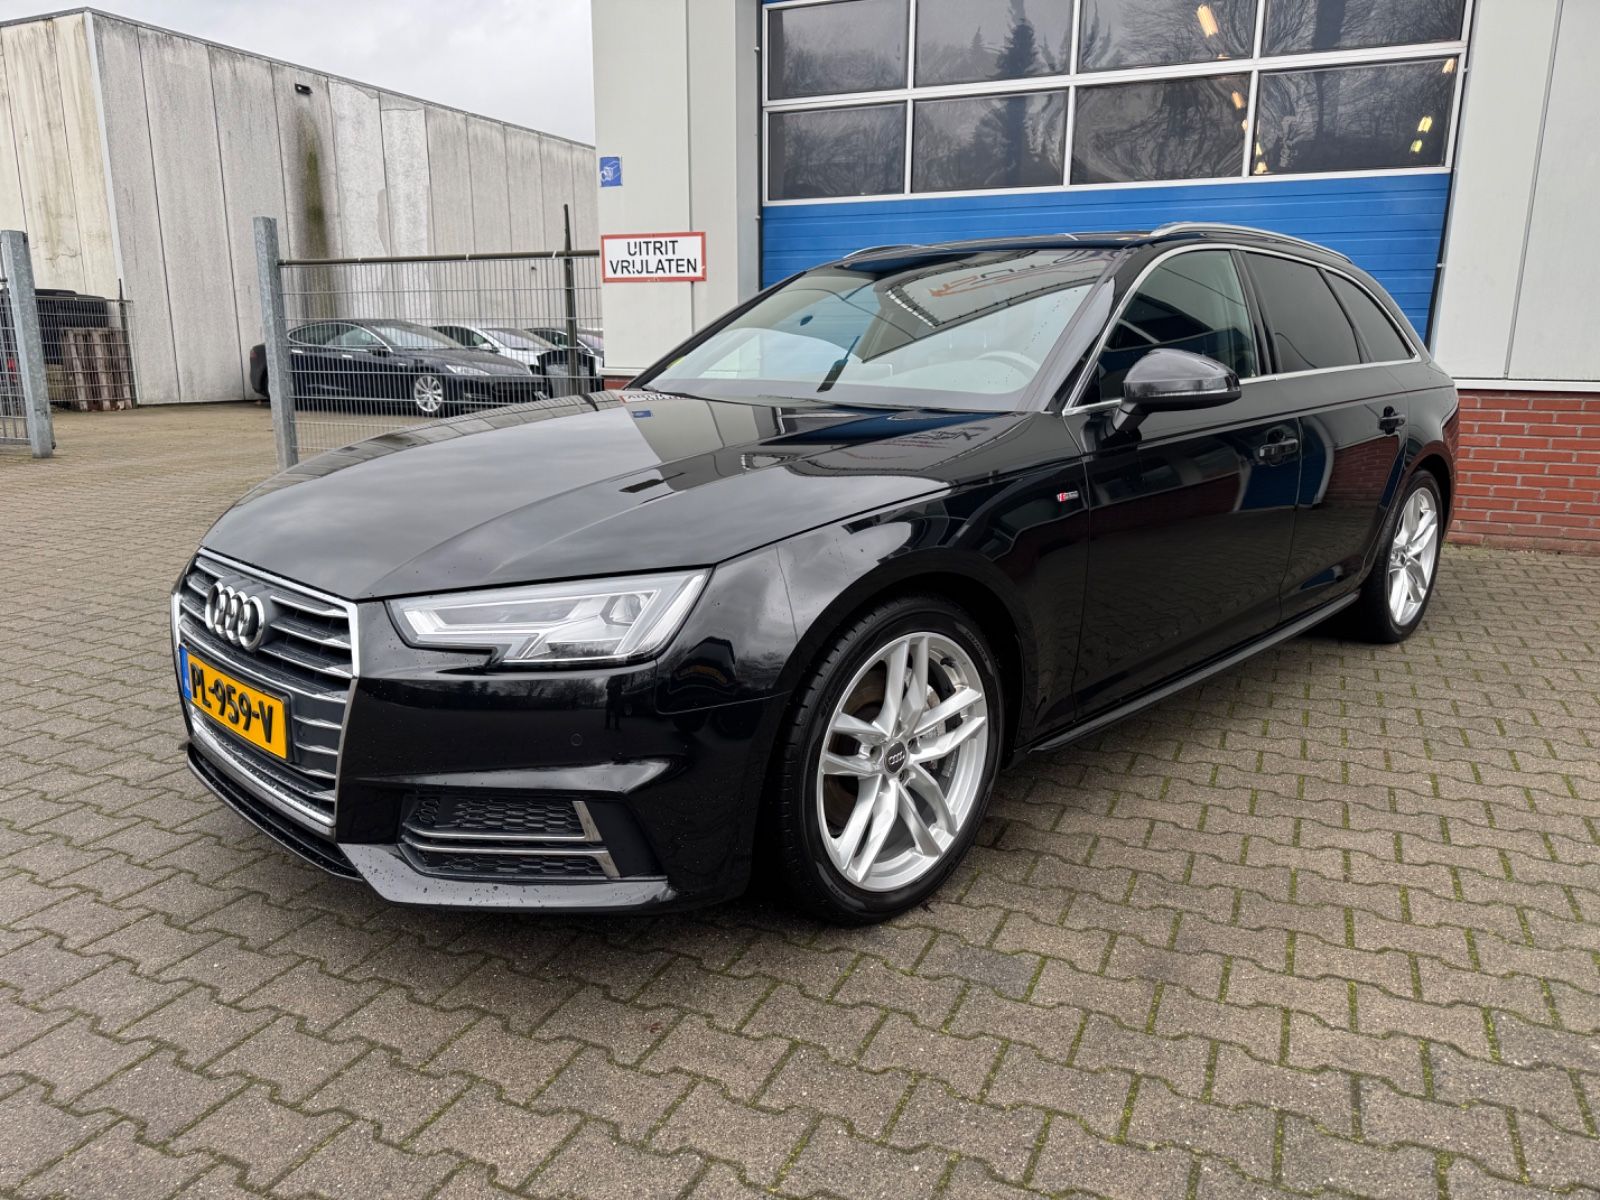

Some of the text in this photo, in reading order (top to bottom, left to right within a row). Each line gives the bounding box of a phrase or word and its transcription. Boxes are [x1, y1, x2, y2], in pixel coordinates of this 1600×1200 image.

[627, 240, 679, 257] UITRIT
[609, 258, 697, 275] VRIJLATEN
[190, 662, 274, 744] PL-959-V
